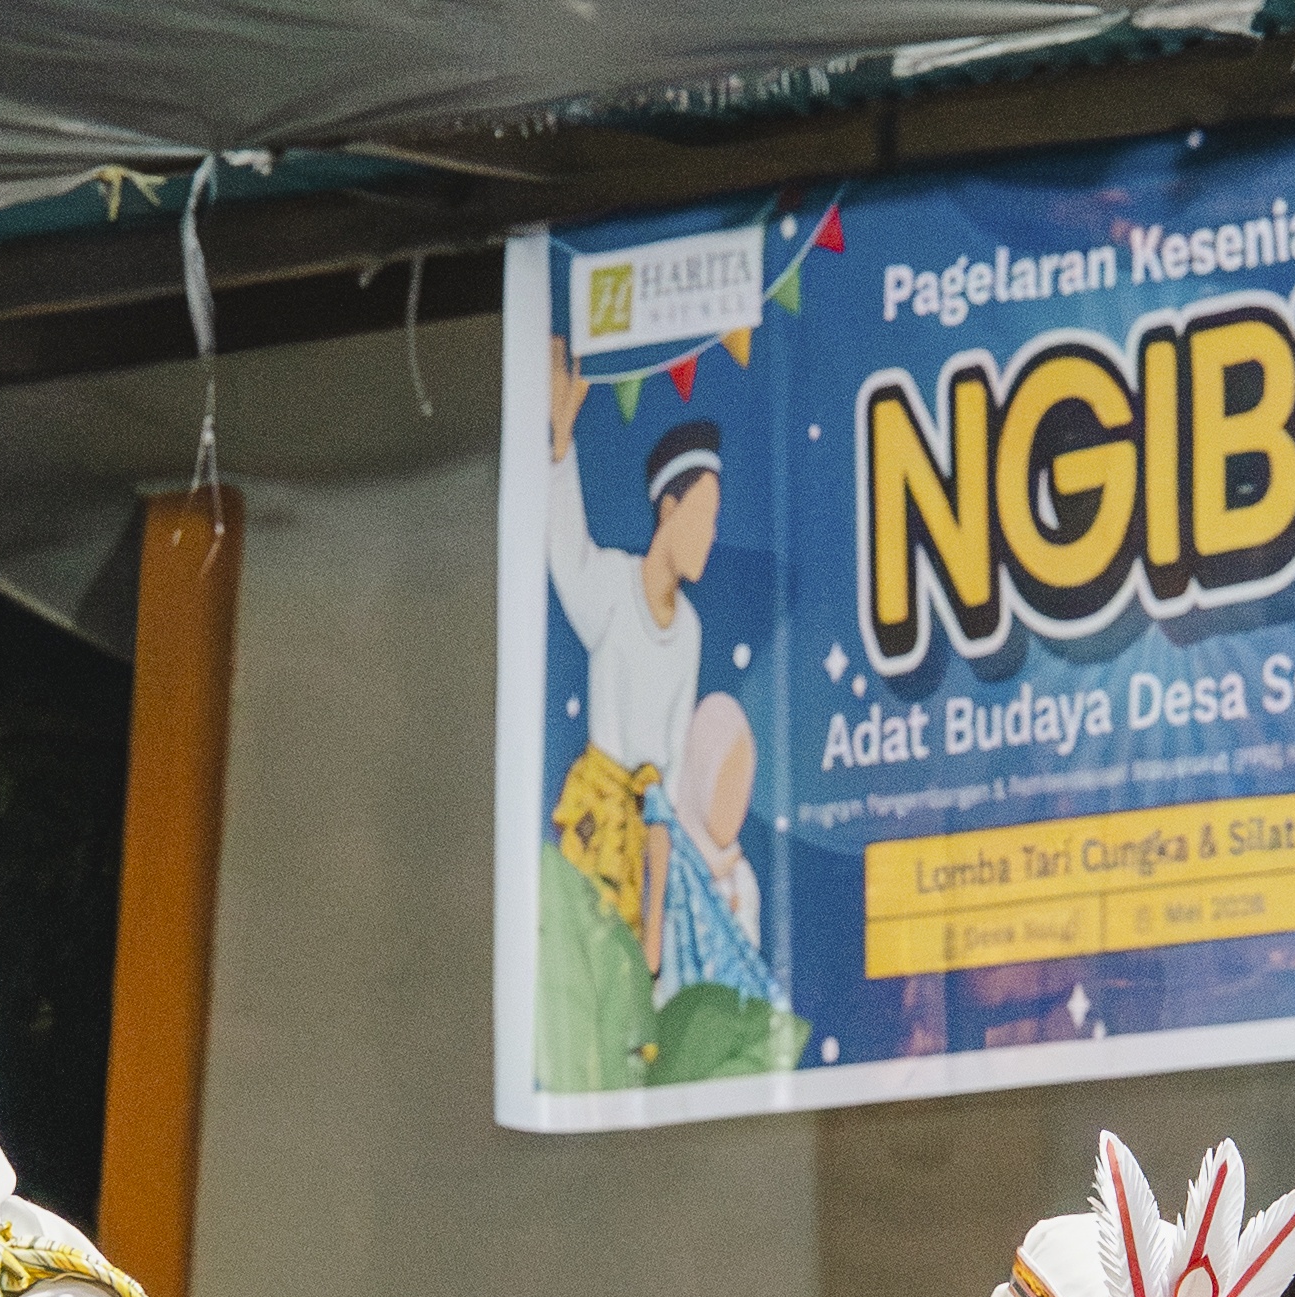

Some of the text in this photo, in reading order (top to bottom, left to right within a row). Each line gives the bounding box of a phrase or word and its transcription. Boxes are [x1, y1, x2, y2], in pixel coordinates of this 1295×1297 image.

[640, 249, 752, 301] HARITA
[882, 244, 1117, 327] Pagelaran
[821, 701, 932, 772] Adat
[944, 681, 1114, 756] Budaya
[1127, 671, 1249, 731] Desa
[914, 847, 1011, 895] Lomba
[1021, 838, 1074, 881] Tari
[1198, 823, 1217, 859] &
